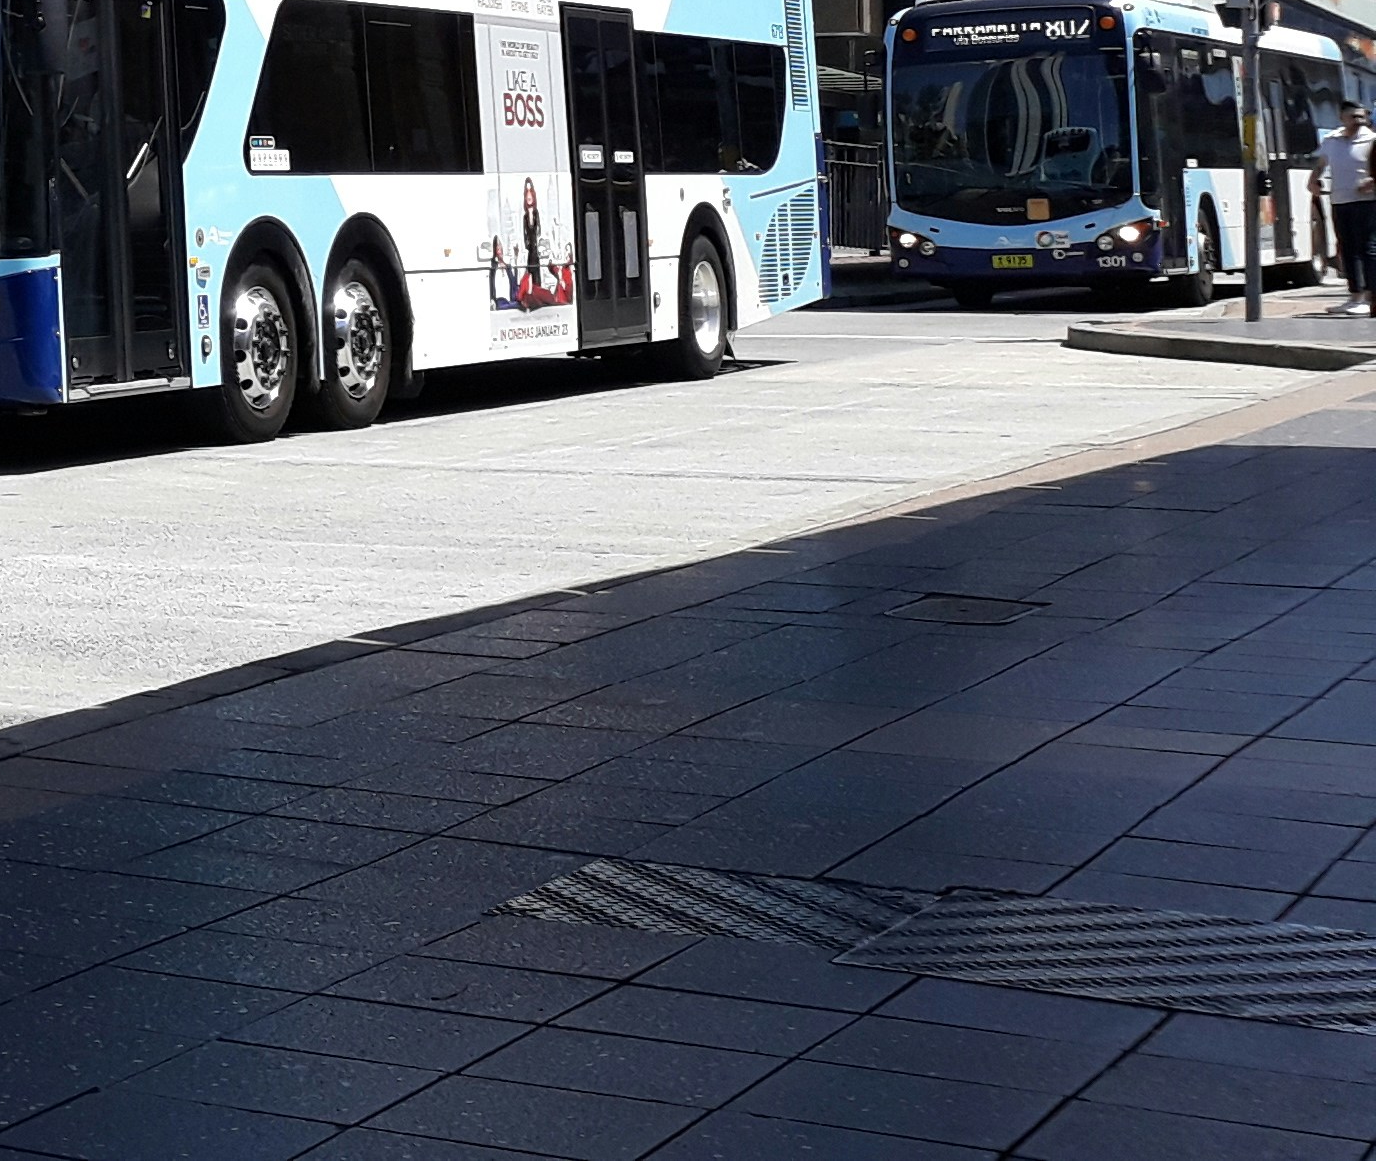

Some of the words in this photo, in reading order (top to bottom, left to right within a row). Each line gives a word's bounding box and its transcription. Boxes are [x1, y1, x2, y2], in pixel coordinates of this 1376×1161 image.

[505, 70, 528, 92] LIKE
[529, 72, 538, 92] A
[503, 93, 545, 128] BOSS
[1098, 255, 1126, 267] 1301
